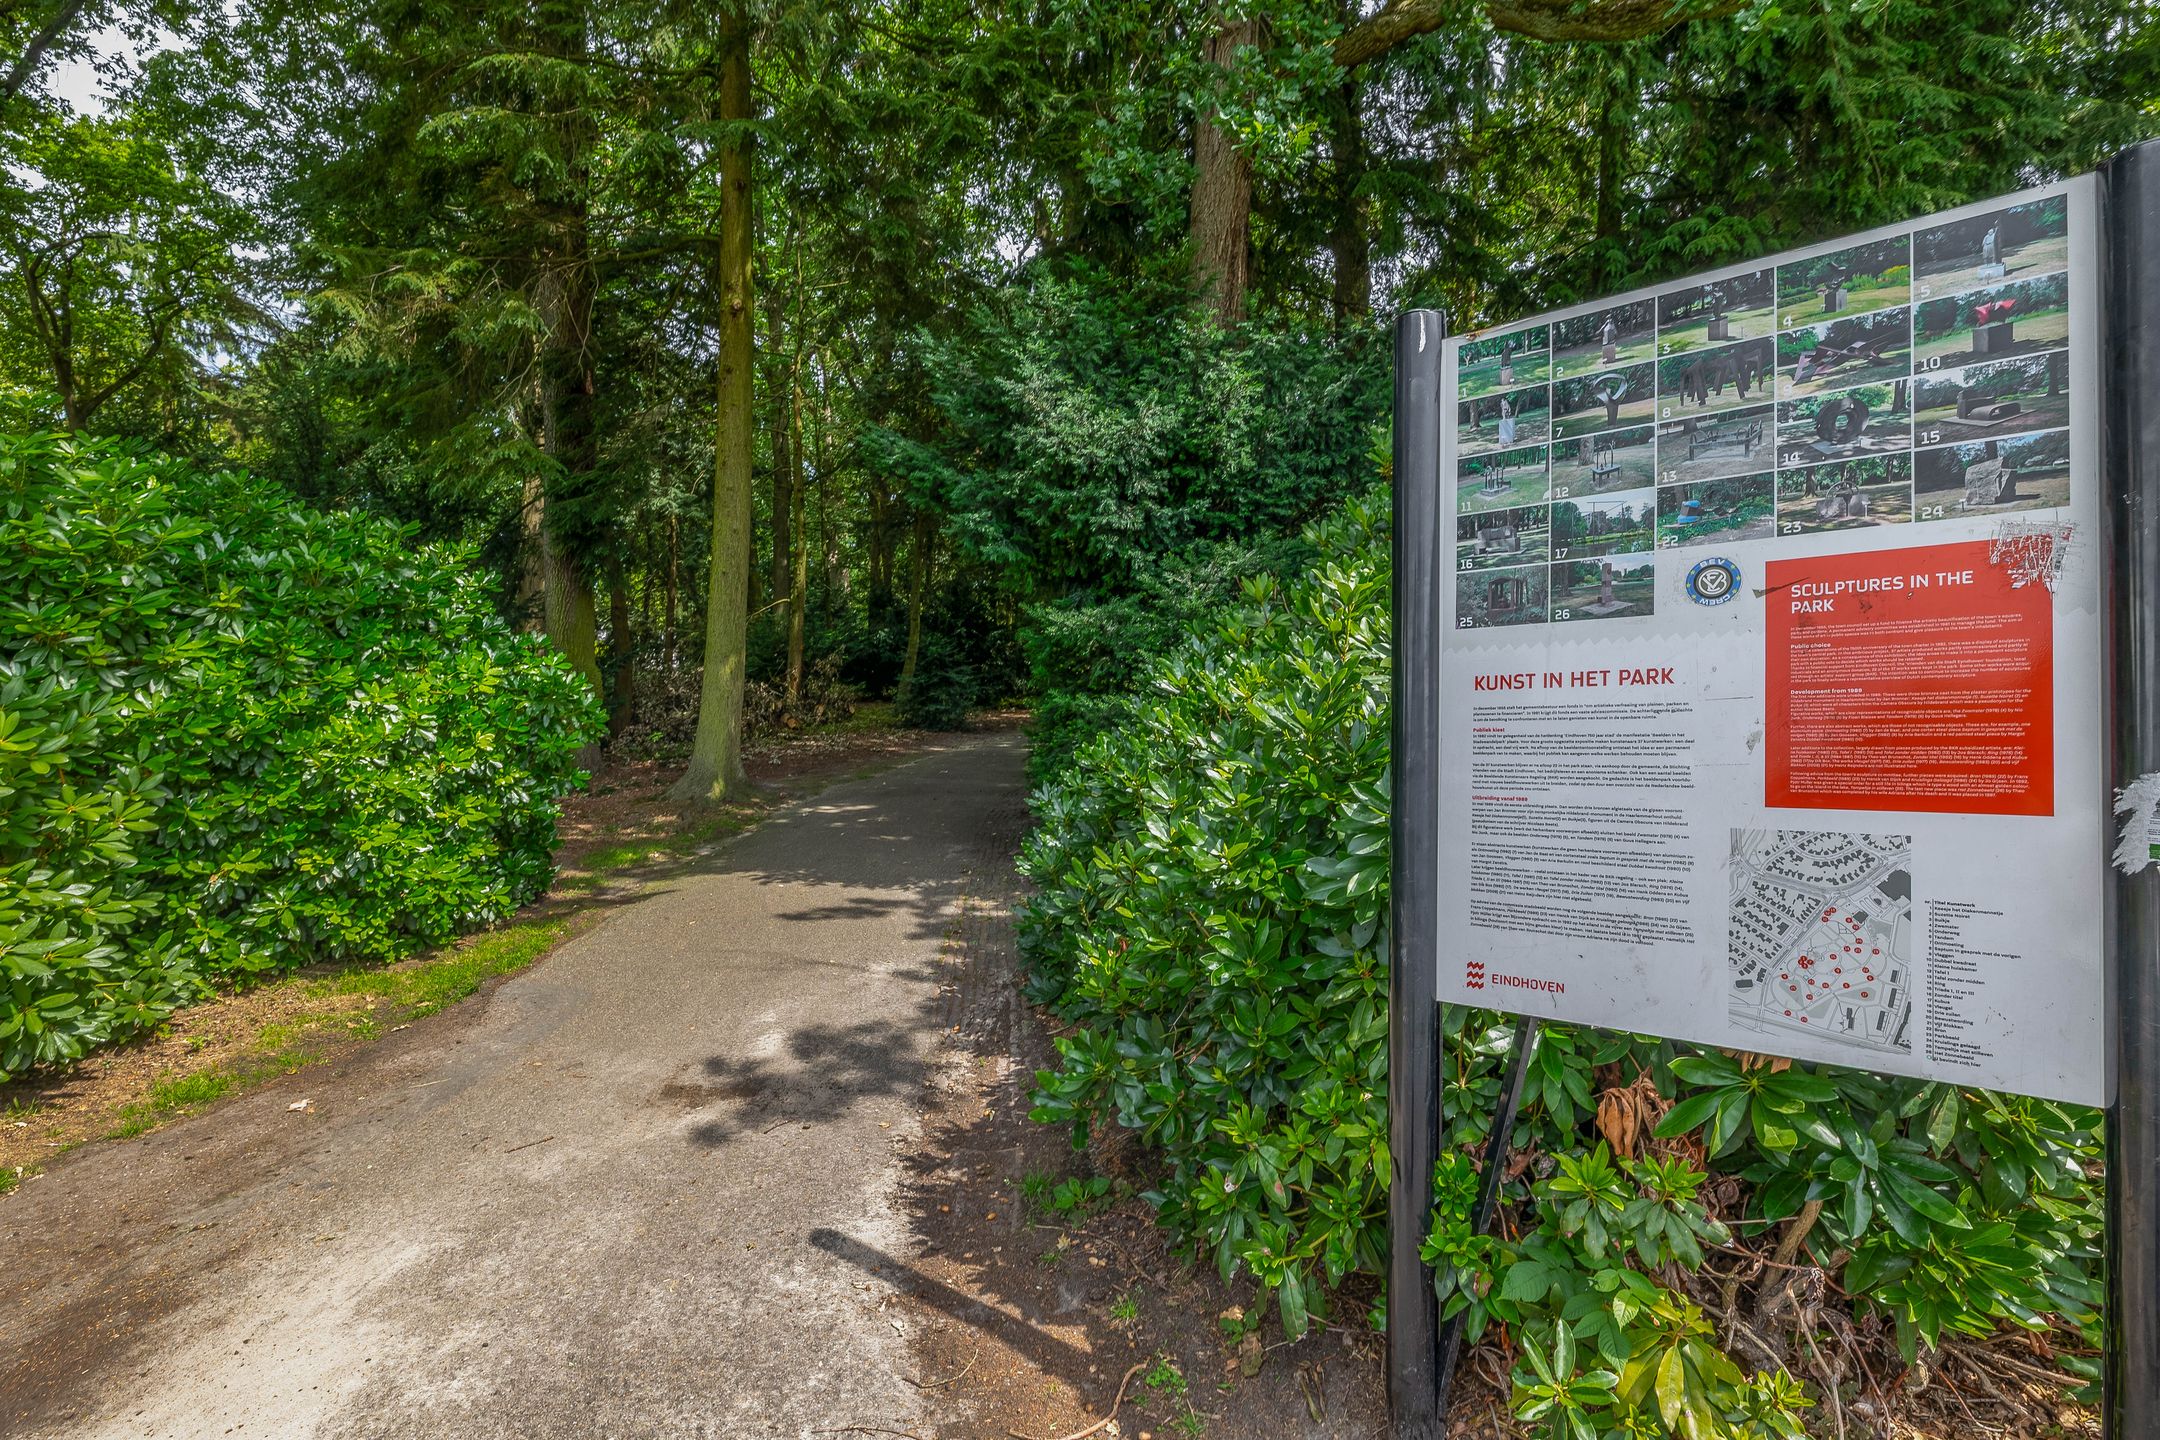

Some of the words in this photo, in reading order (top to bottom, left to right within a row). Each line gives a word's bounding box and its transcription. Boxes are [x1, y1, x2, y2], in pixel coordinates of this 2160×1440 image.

[1921, 286, 1930, 298] 5
[1783, 315, 1792, 326] 4
[1662, 344, 1670, 354] 3
[1921, 356, 1940, 370] 10
[1556, 367, 1564, 376] 2
[1462, 388, 1467, 397] 1
[1662, 407, 1670, 418] 8
[1556, 427, 1564, 438] 7
[1921, 430, 1940, 444] 15
[1783, 452, 1800, 464] 14
[1662, 470, 1676, 482] 13
[1556, 487, 1568, 498] 12
[1461, 502, 1471, 512] 11
[1922, 506, 1944, 519] 24
[1783, 521, 1802, 534] 23
[1662, 535, 1678, 546] 22
[1556, 548, 1568, 559] 17
[1460, 559, 1472, 569] 16
[1700, 558, 1726, 568] BEV
[1791, 576, 1904, 598] SCULPTURES
[1910, 574, 1929, 588] IN
[1936, 570, 1974, 586] THE
[1699, 595, 1731, 606] CREW
[1791, 599, 1834, 614] PARK
[1556, 609, 1570, 620] 26
[1460, 617, 1473, 627] 25
[1474, 673, 1536, 691] KUNST
[1543, 671, 1563, 689] IN
[1570, 670, 1611, 688] HET
[1618, 668, 1675, 686] PARK
[1492, 974, 1565, 994] EINDHOVEN
